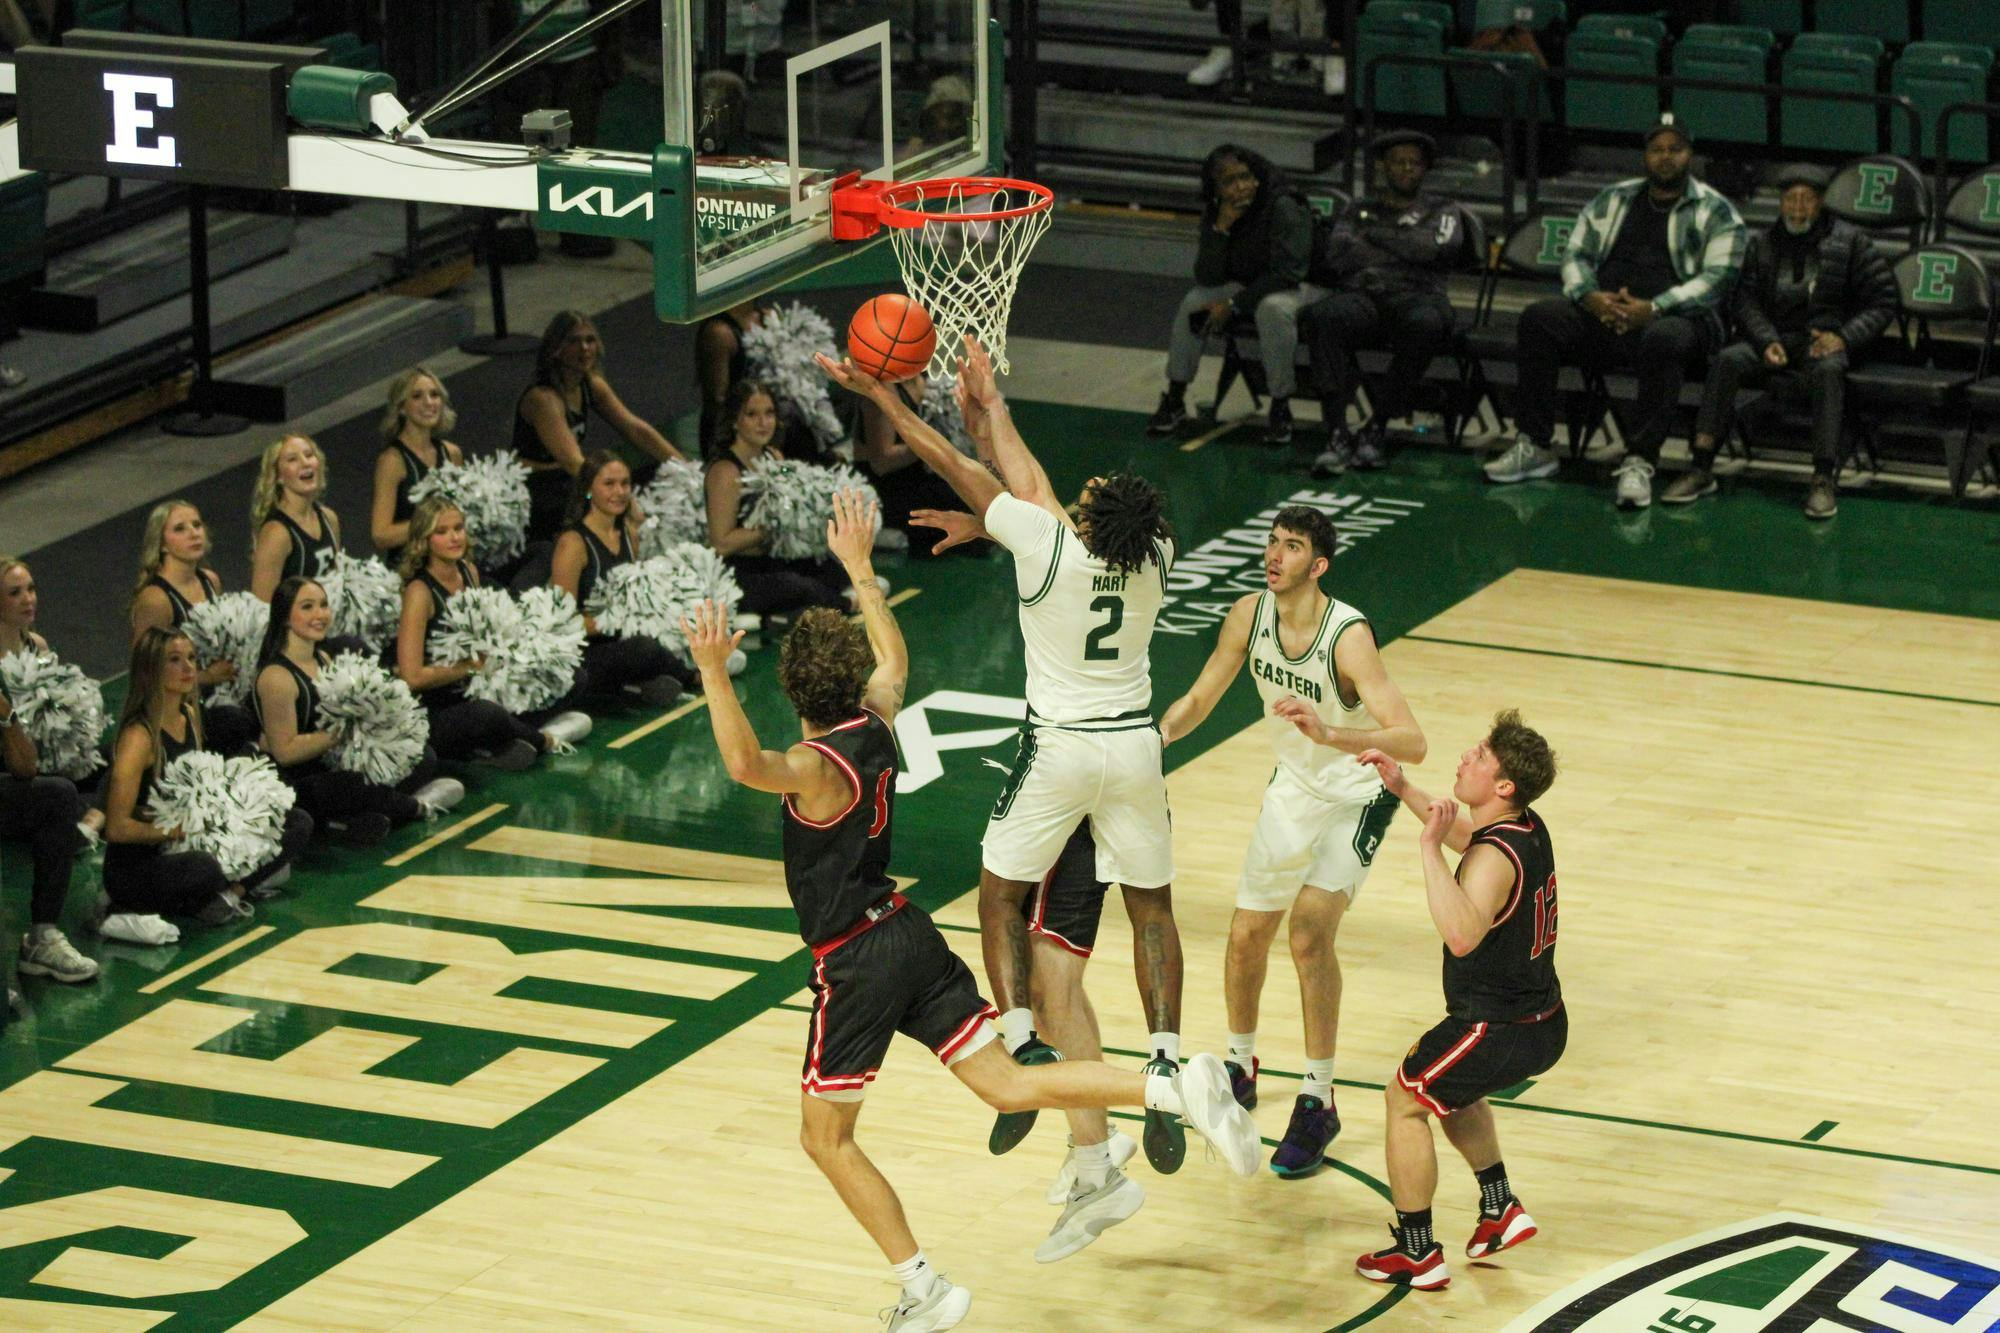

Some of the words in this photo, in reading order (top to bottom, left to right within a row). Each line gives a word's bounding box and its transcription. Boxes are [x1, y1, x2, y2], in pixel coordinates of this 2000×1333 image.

[103, 72, 176, 167] E
[549, 182, 653, 221] KIA
[1853, 163, 1898, 214] E
[698, 214, 757, 231] YPSILA
[1913, 252, 1958, 304] E
[1092, 575, 1129, 592] HART
[1084, 595, 1124, 661] 2
[1530, 871, 1558, 960] 12
